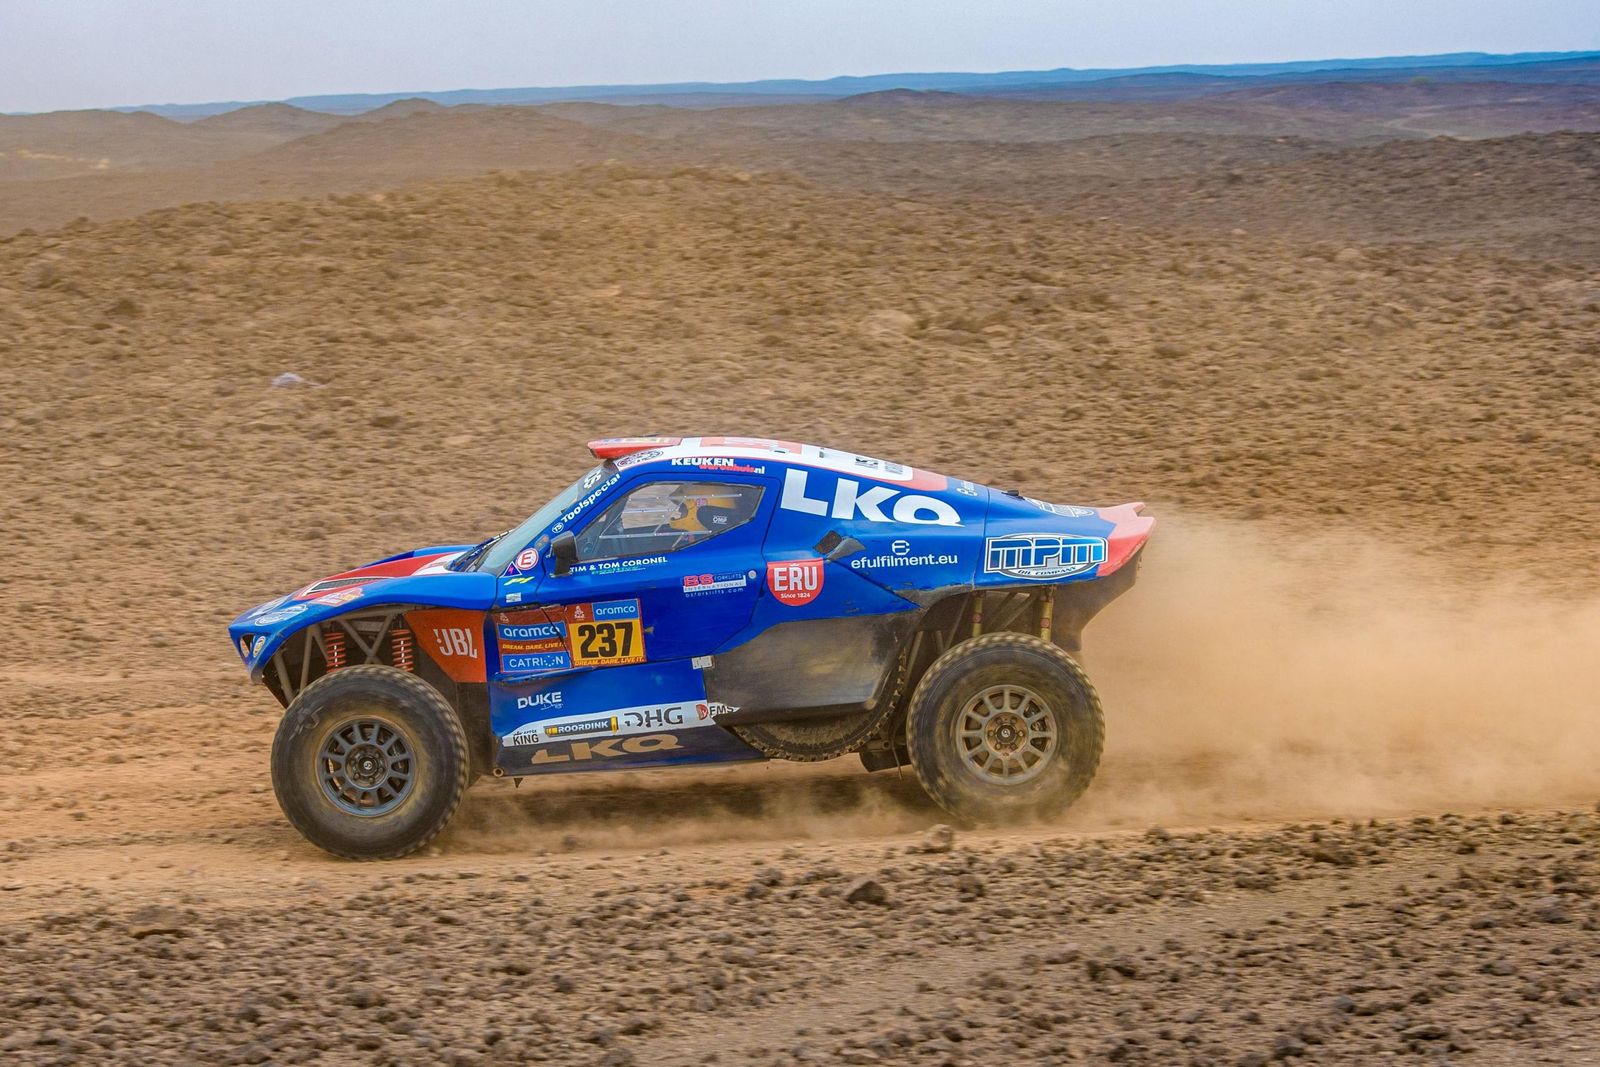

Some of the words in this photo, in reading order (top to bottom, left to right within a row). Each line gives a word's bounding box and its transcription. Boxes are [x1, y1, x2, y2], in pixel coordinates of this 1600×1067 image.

[671, 458, 734, 466] KEUKEN
[561, 473, 621, 523] Toolspecial
[780, 468, 966, 528] LKQ
[598, 561, 620, 570] TOM
[622, 556, 669, 567] CORONEL
[851, 554, 958, 569] efulfilment.eu
[684, 574, 714, 587] BS
[595, 605, 636, 616] aramco
[503, 627, 560, 638] aramco
[577, 622, 633, 659] 237
[517, 691, 562, 709] DUKE
[558, 720, 609, 734] ROORDINK
[513, 733, 539, 746] KING
[531, 734, 684, 764] LKQ
